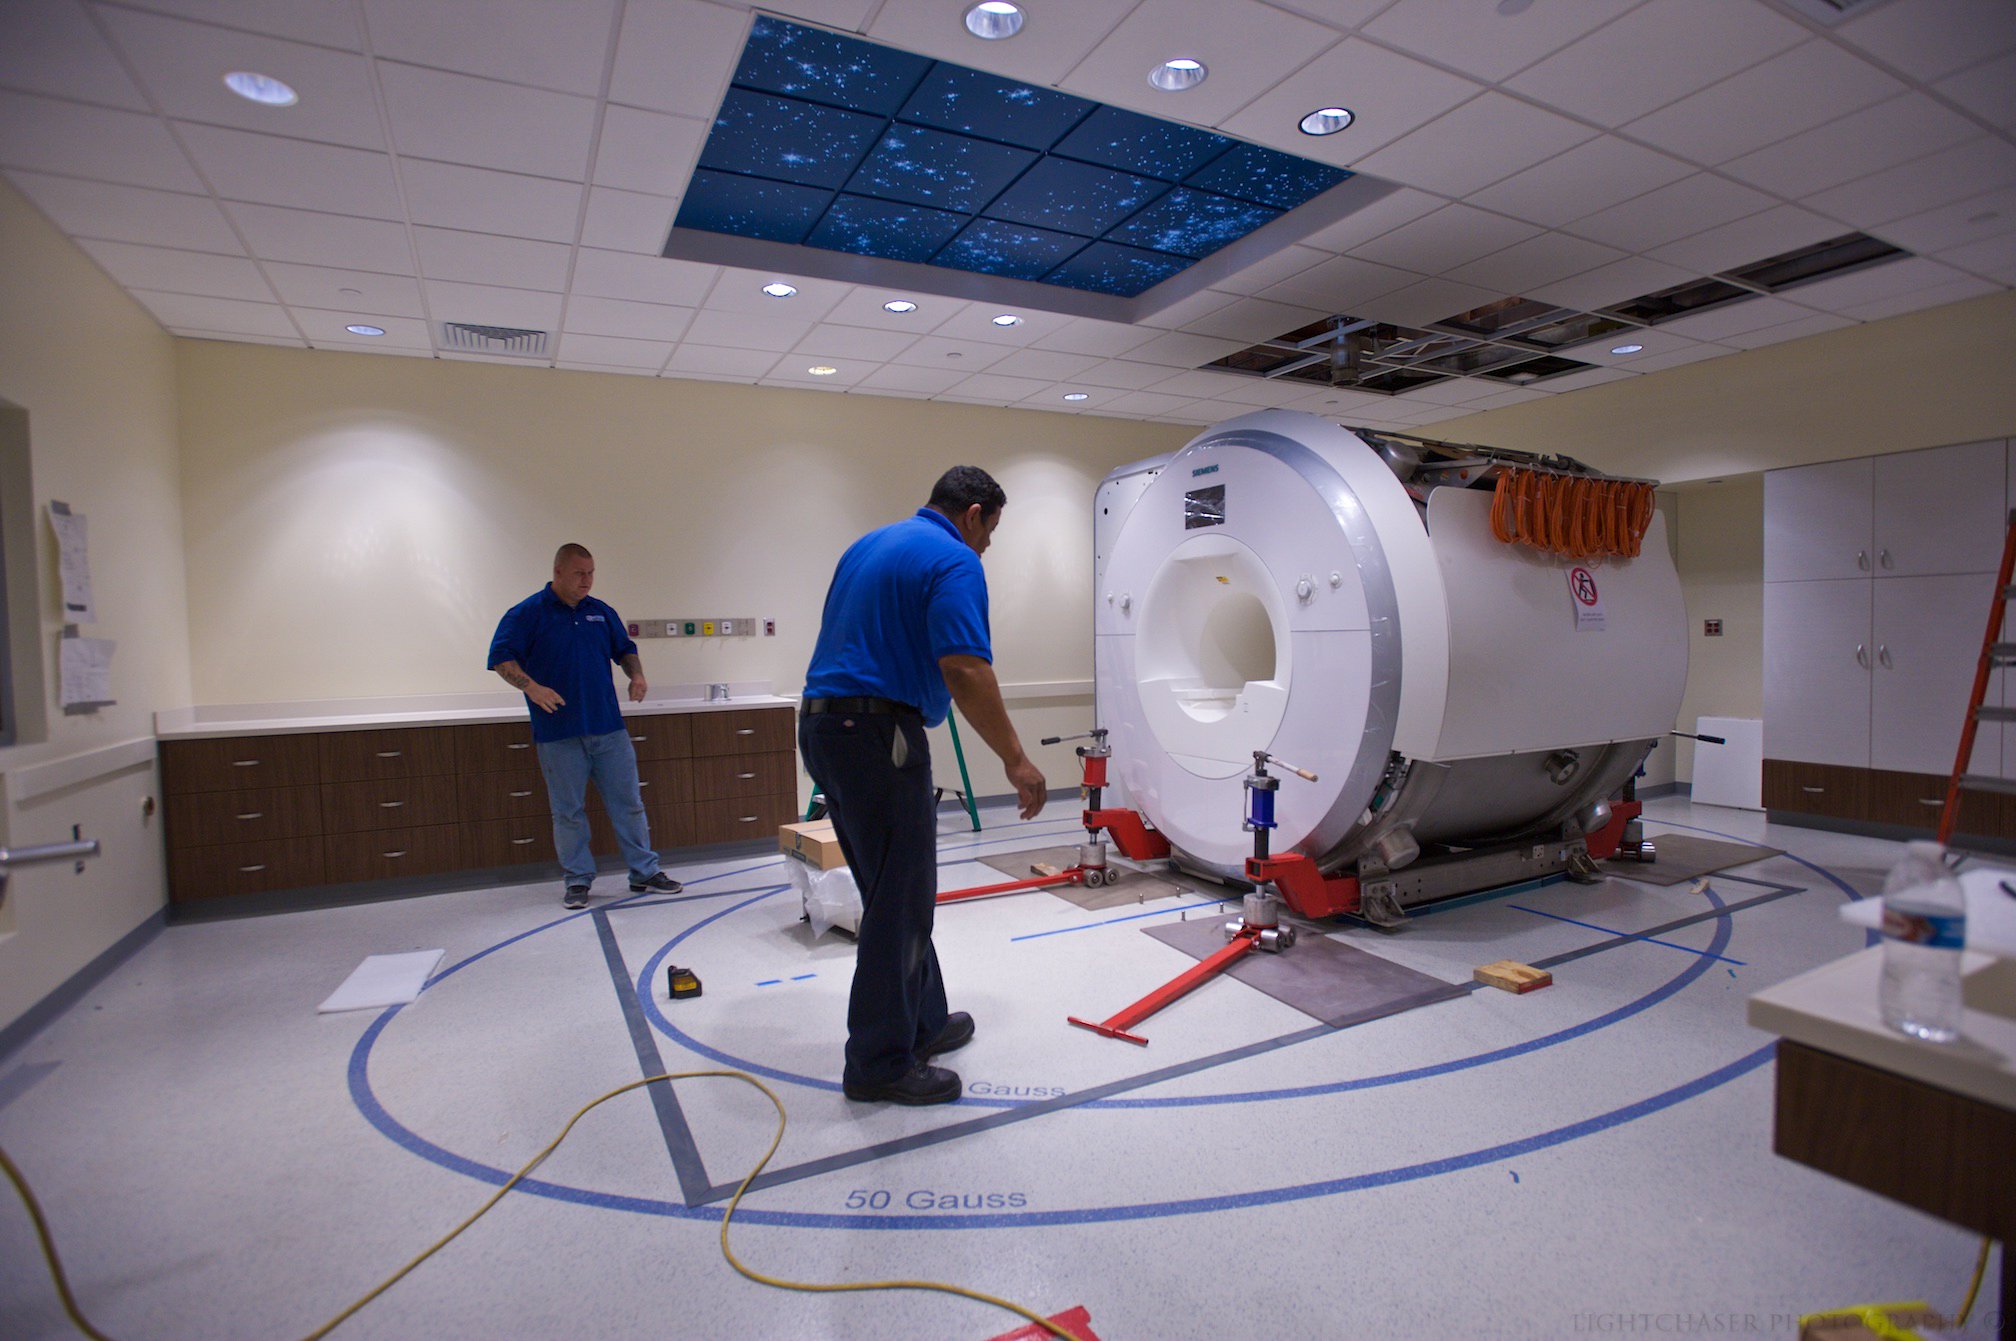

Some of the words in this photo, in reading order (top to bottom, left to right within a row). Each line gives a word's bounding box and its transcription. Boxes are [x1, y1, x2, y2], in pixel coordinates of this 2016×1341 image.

[1192, 464, 1219, 477] SIEMENS
[968, 1081, 1066, 1098] Gauss
[845, 1189, 891, 1210] 50
[905, 1190, 1027, 1210] Gauss
